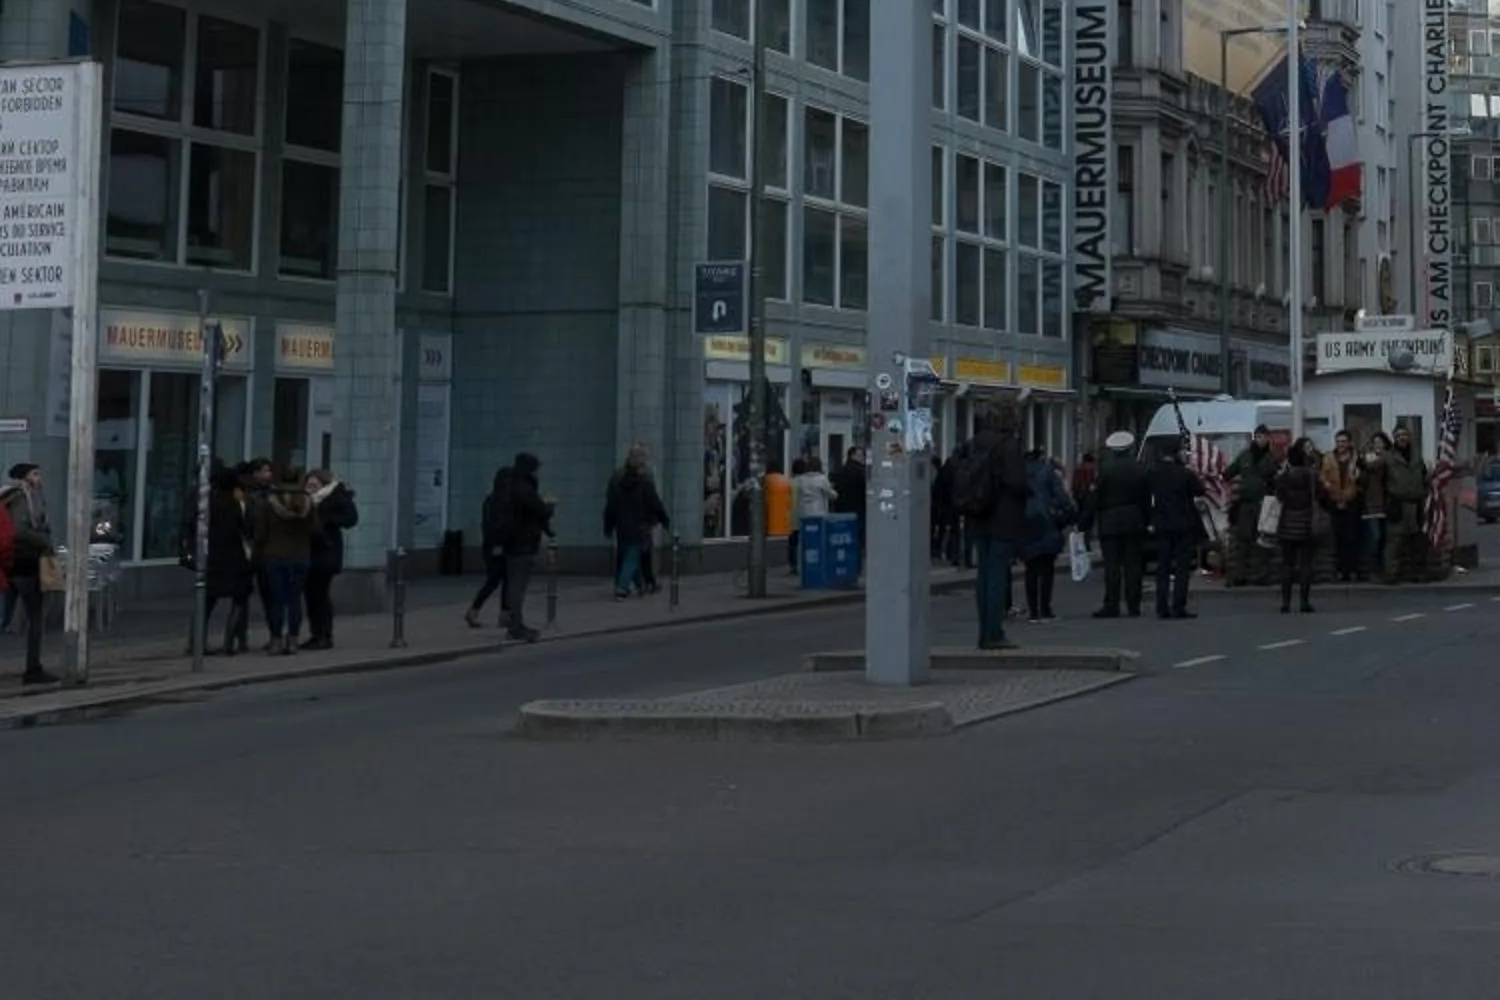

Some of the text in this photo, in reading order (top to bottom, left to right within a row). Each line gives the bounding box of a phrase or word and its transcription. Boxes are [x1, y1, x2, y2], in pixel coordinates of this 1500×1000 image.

[22, 77, 64, 95] SECTOR
[1074, 5, 1106, 297] MAUERMUSEUM
[1427, 103, 1448, 254] CHECKPOINT
[3, 203, 65, 219] AMERICAIN
[21, 265, 62, 284] SEKTOR
[1429, 262, 1449, 300] AM
[107, 326, 203, 351] MAUERMUSEU
[1325, 341, 1341, 358] US
[1345, 340, 1377, 357] ARMY
